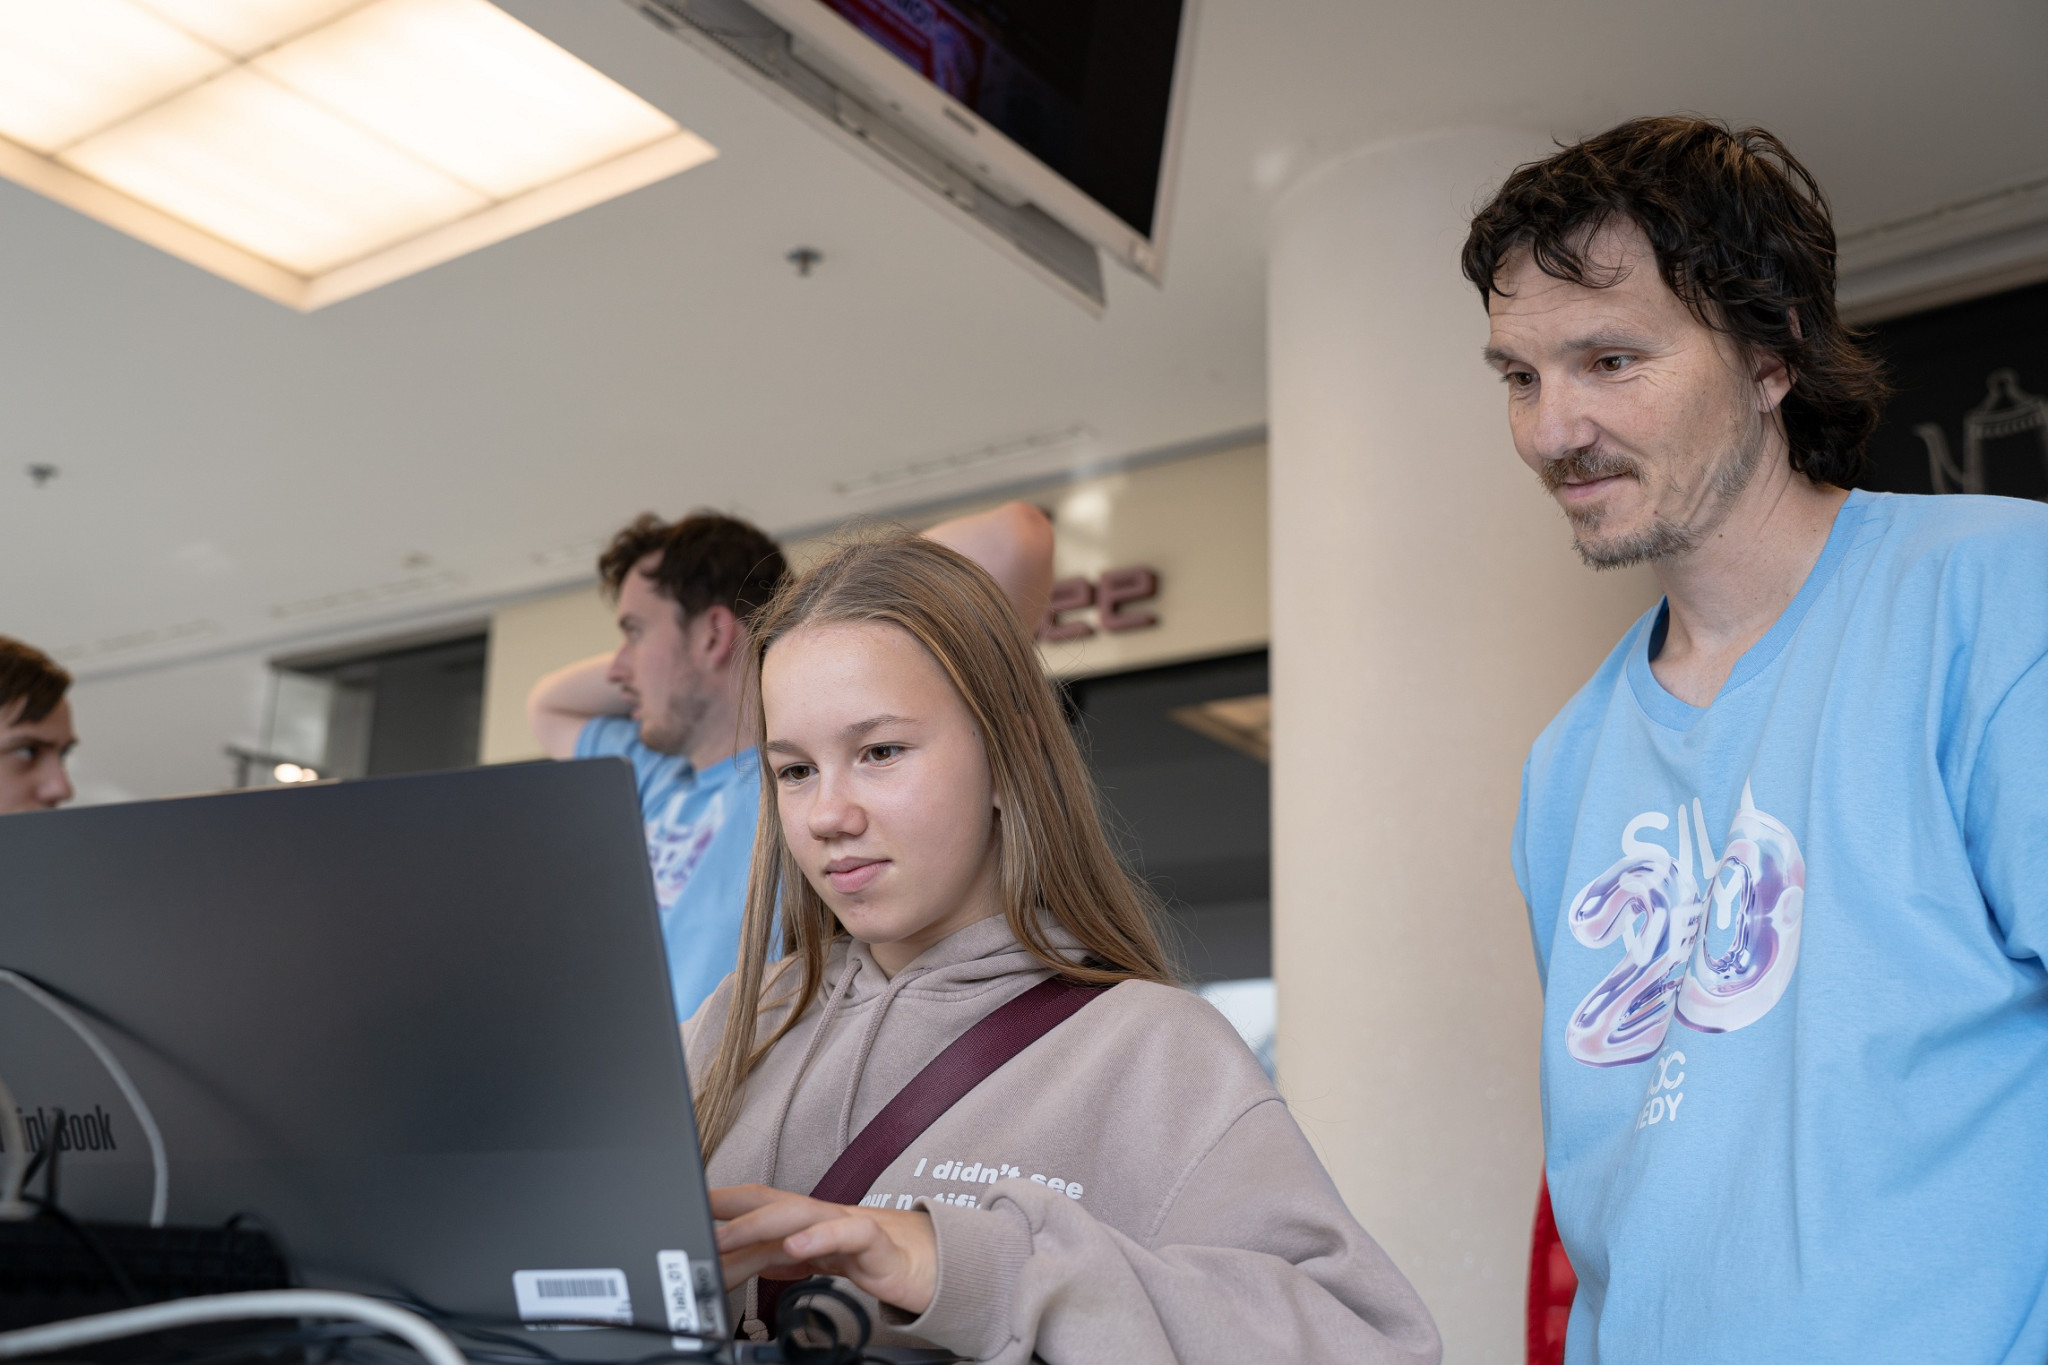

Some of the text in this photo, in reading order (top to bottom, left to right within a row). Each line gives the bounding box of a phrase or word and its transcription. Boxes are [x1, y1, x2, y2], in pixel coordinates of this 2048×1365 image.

[913, 1157, 1084, 1200] I didn't see
